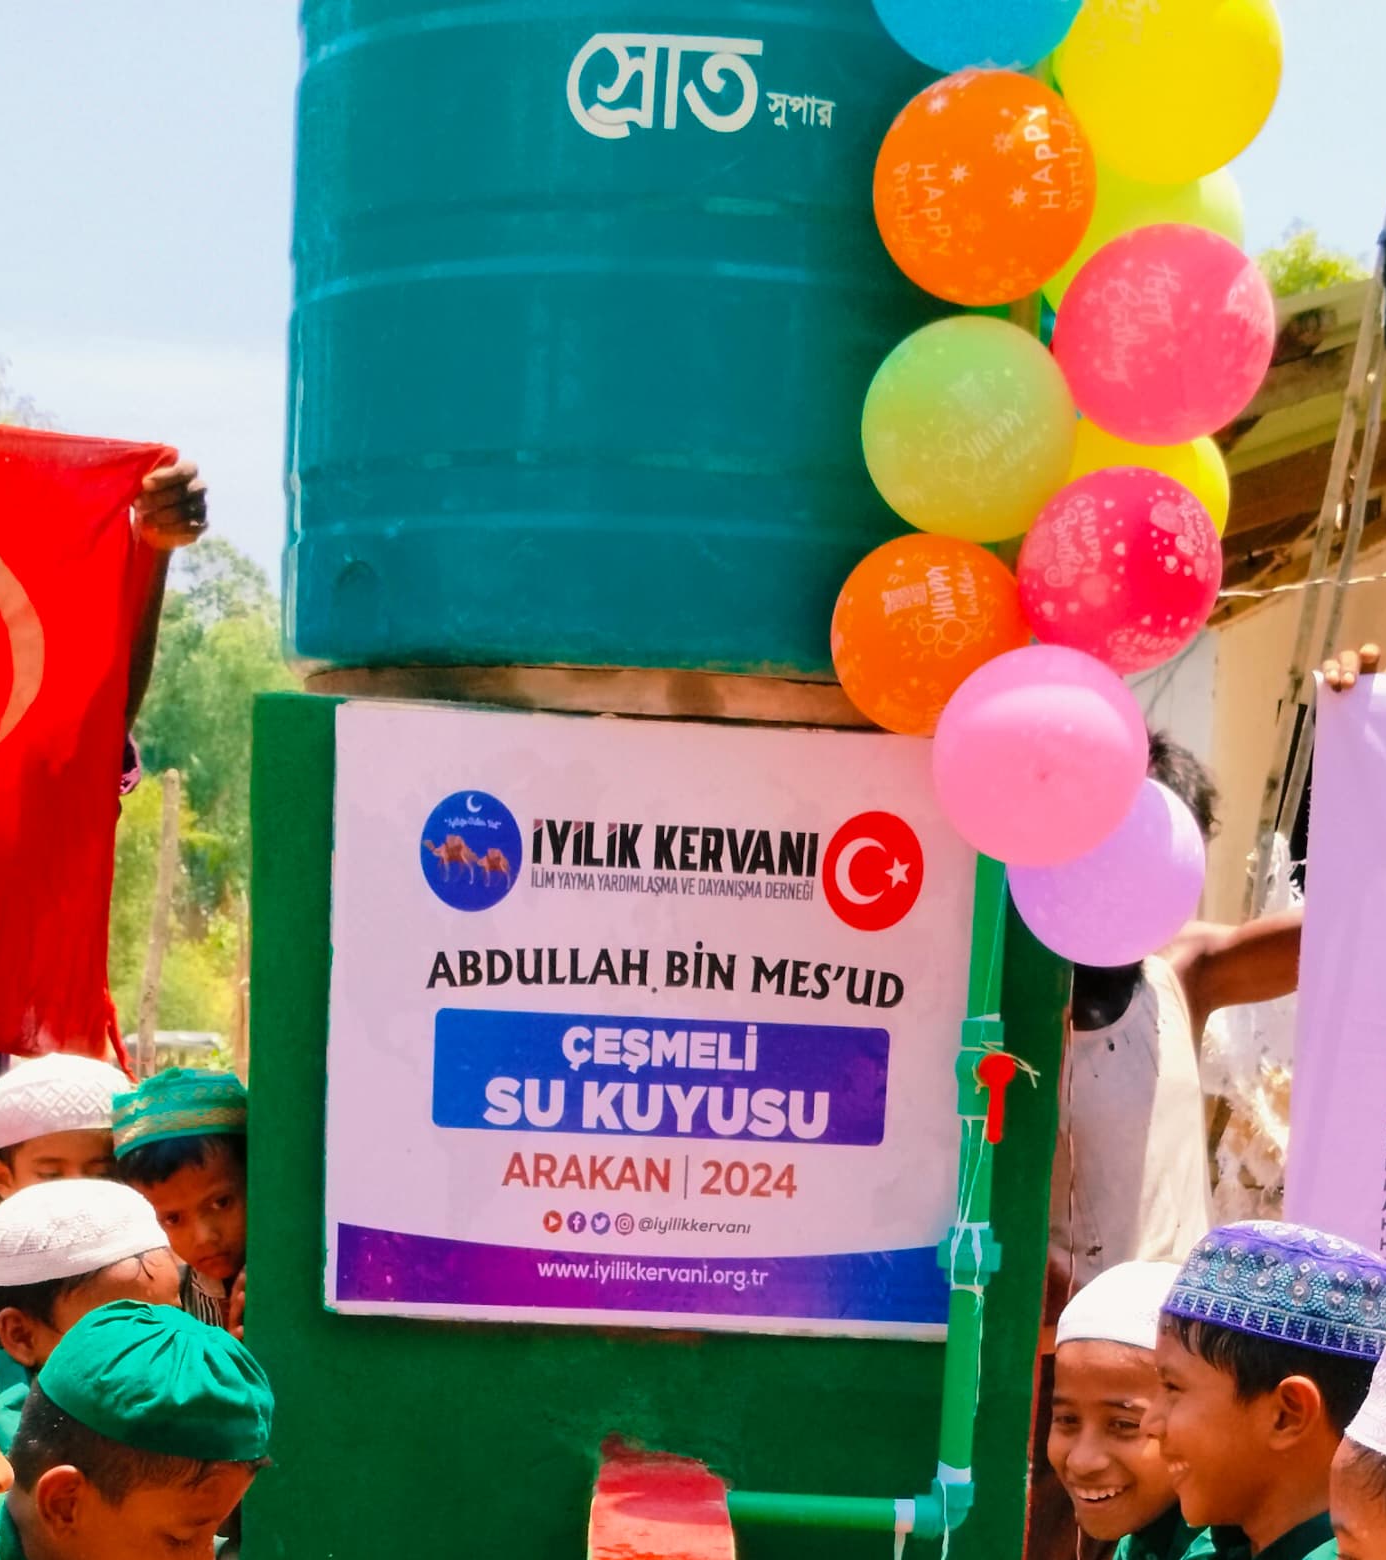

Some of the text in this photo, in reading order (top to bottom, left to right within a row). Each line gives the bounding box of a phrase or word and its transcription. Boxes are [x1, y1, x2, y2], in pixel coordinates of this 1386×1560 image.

[766, 92, 835, 129] সুপার
[1023, 105, 1061, 209] HAPPY
[916, 164, 952, 256] HAPPY
[532, 818, 819, 877] İYİLİK KERVANI
[557, 871, 595, 891] YAYMA
[598, 873, 678, 897] YARDIMLAŞMA
[681, 878, 695, 895] VE
[698, 878, 762, 900] DAYANIŞMA
[765, 880, 814, 901] DERNEĞİ
[426, 947, 650, 990] ABDULLAH
[665, 941, 737, 991] BİN
[562, 1024, 758, 1074] ÇEŞMELİ
[483, 1077, 830, 1140] SU KUYUSU
[502, 1153, 797, 1199] ARAKAN 2024
[537, 1260, 769, 1291] www.iyilikkervani.org.tr
